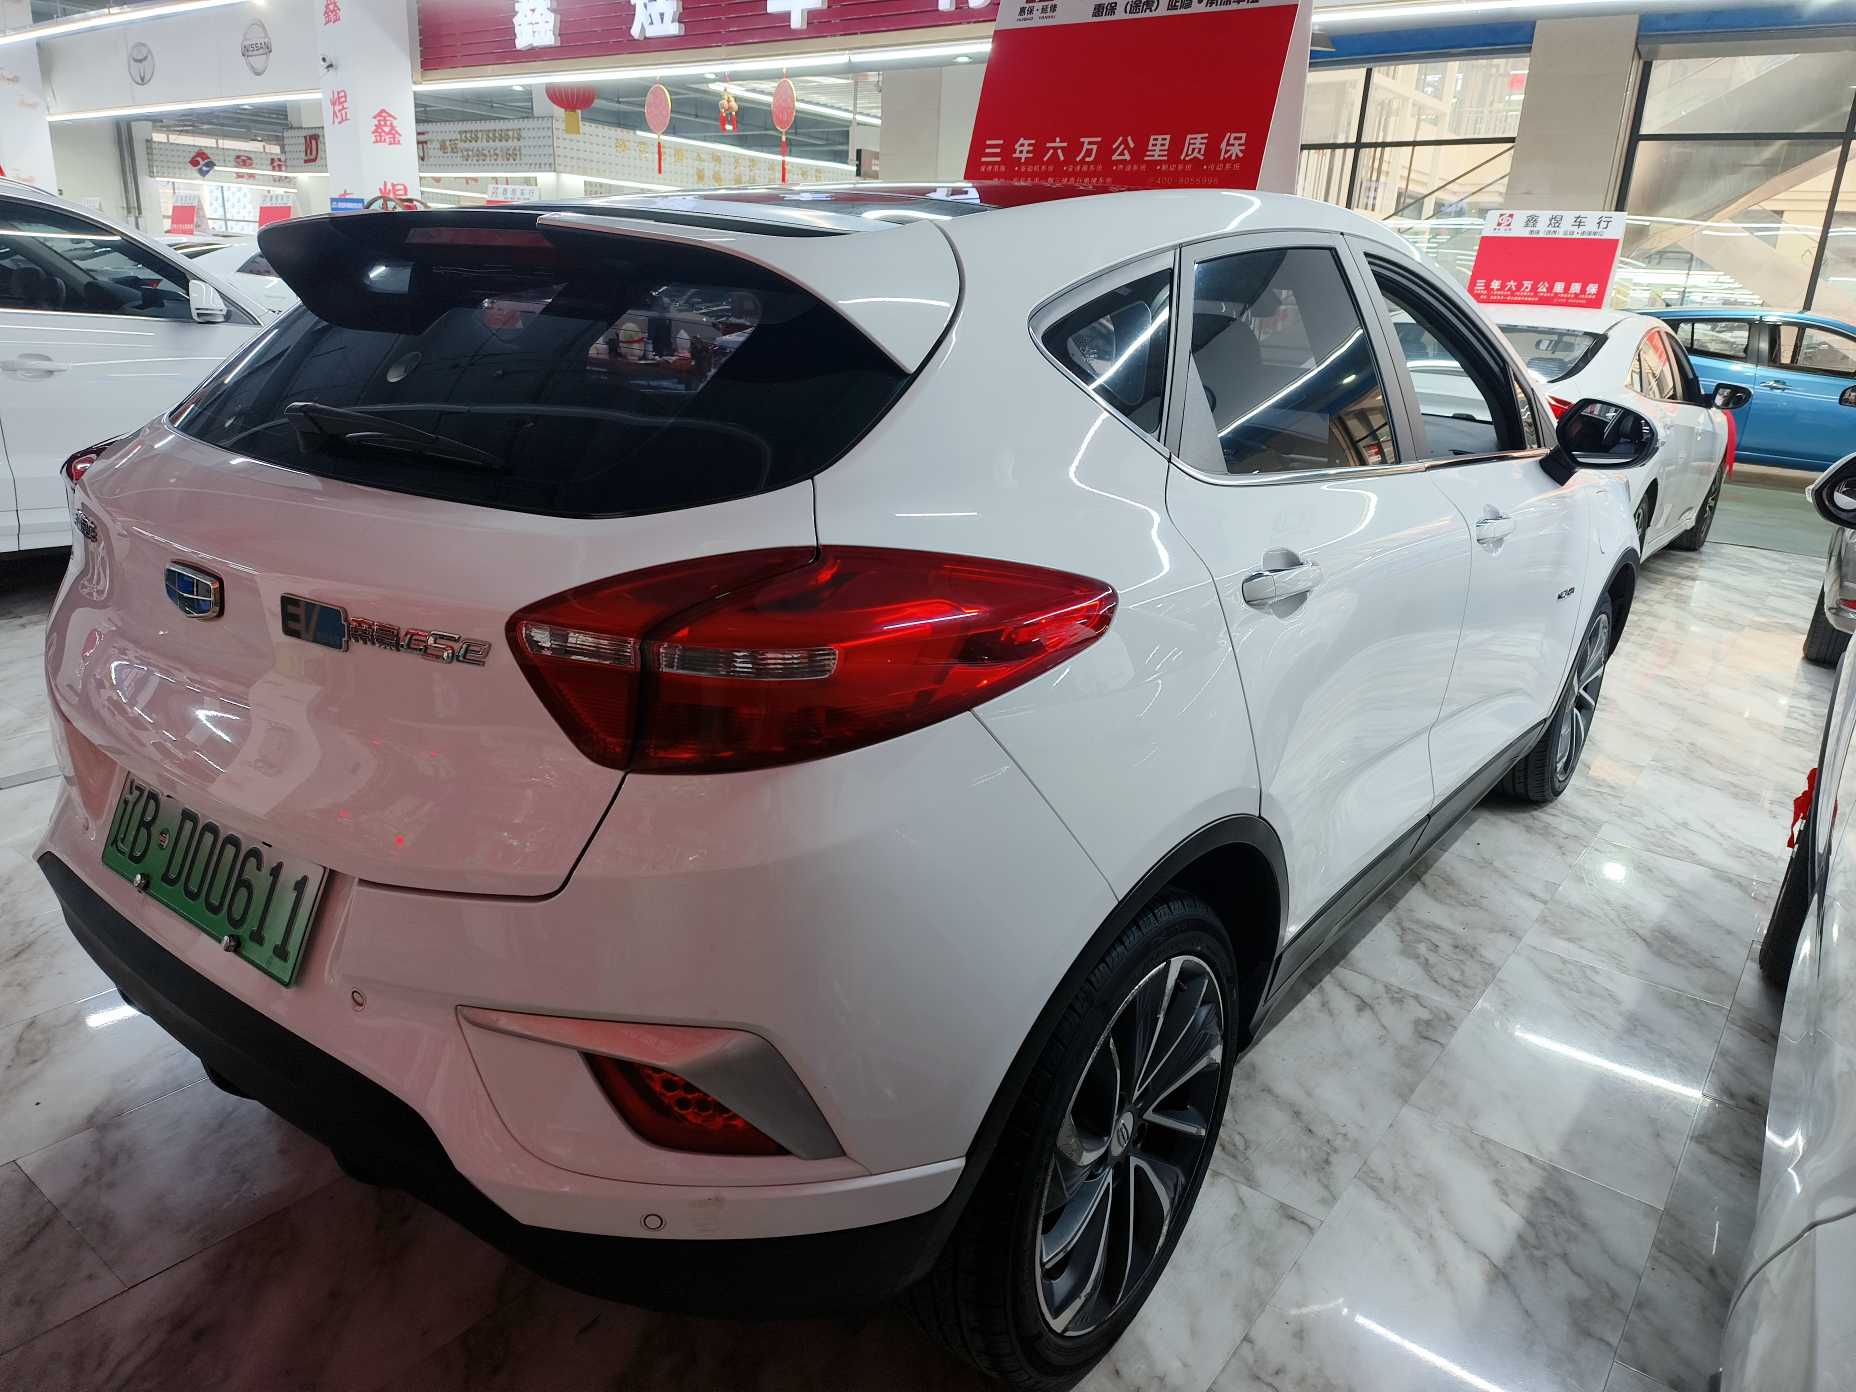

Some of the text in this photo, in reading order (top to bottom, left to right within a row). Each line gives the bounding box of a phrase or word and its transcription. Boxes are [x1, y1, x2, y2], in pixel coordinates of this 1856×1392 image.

[243, 41, 270, 53] NISSAN
[980, 132, 1248, 162] 三年六万公里质保
[1523, 214, 1613, 230] 鑫煜车行
[1474, 279, 1600, 296] 三年六万公里质保
